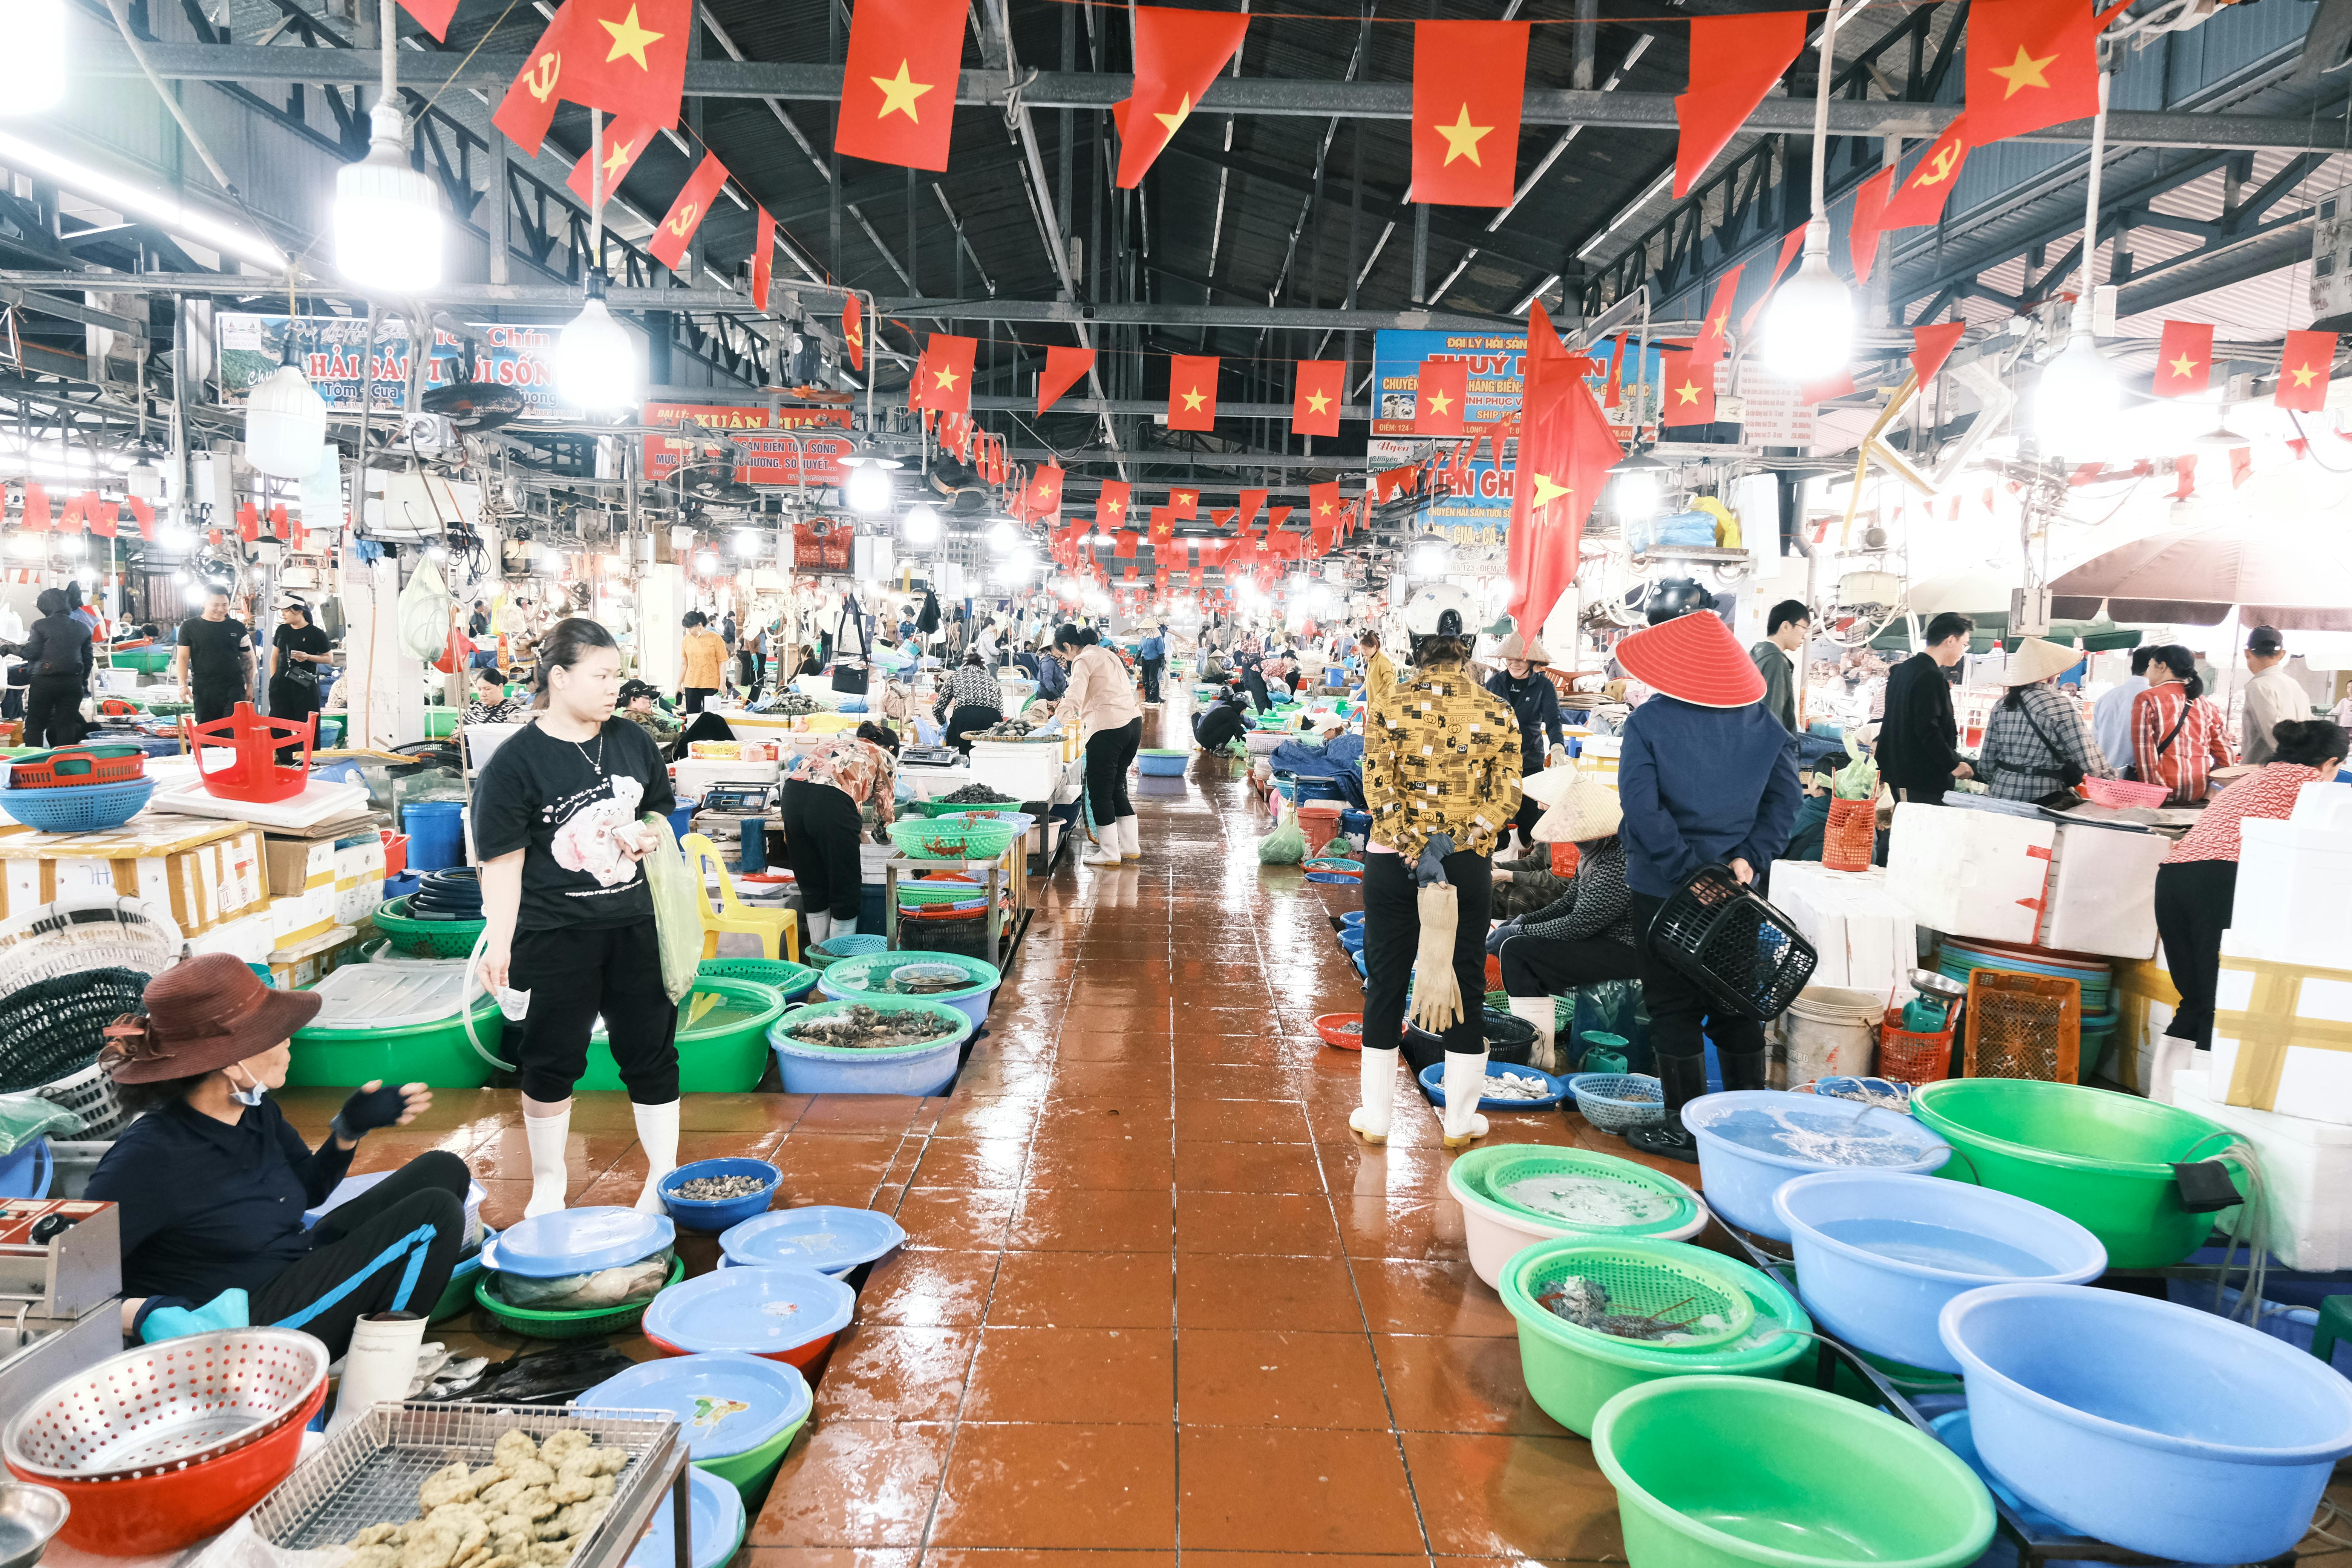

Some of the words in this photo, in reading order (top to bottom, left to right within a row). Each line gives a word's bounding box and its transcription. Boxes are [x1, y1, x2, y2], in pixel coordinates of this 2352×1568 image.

[487, 327, 550, 348] Chín
[1446, 337, 1466, 350] ĐẠI
[1467, 337, 1482, 349] LÝ
[1485, 336, 1503, 349] HẢI
[1505, 336, 1527, 349] SẢN
[309, 345, 359, 380] HẢI
[499, 351, 557, 386] SỐN
[1428, 351, 1511, 375] UÝ
[324, 383, 357, 398] Tôm
[371, 384, 398, 398] Cua
[522, 392, 558, 406] ương
[1383, 376, 1419, 391] CHUYÊN
[1468, 378, 1495, 393] HÀNG
[1626, 384, 1651, 397] MC
[1465, 394, 1482, 405] ÌNH
[1485, 397, 1513, 408] PHỤC
[657, 409, 674, 419] ĐẠI
[675, 409, 689, 418] LÝ:
[694, 411, 762, 429] XUÂN
[776, 418, 815, 430] UA
[1477, 410, 1499, 420] SHIP
[763, 438, 784, 452] BIỂN
[811, 440, 836, 454] SỐNG
[785, 457, 796, 468] SÒ
[1427, 506, 1455, 516] CHUYÊN
[1456, 505, 1468, 517] HẢI
[1470, 506, 1485, 518] SẢN
[1423, 523, 1446, 538] TM
[1453, 525, 1474, 545] CUA
[1482, 522, 1496, 546] CÁ
